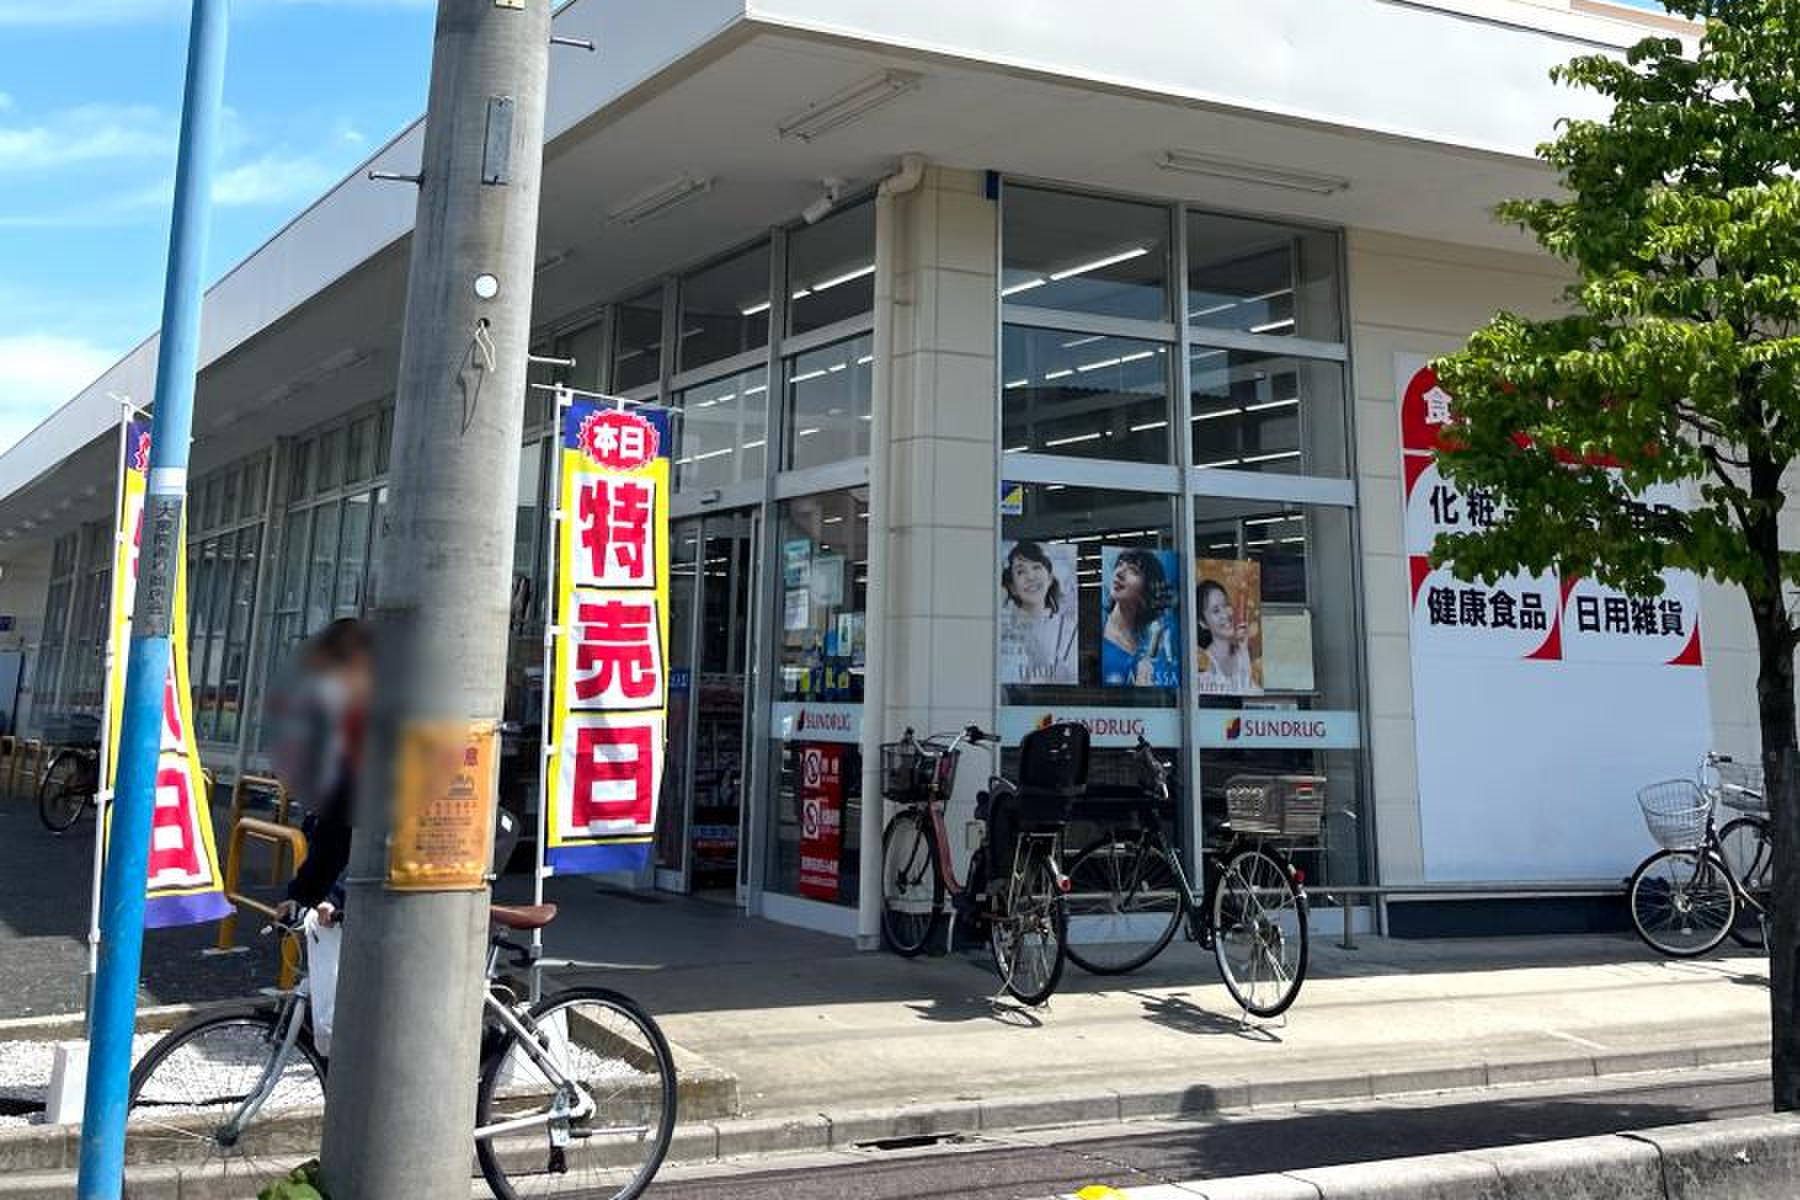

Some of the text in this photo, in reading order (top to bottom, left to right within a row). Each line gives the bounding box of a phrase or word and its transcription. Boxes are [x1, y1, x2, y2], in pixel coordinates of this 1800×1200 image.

[593, 423, 645, 460] 本日
[1427, 586, 1547, 631] 健康食品
[1576, 595, 1685, 637] 日用雑貨
[571, 481, 656, 828] 特売日
[1057, 717, 1146, 737] NDRUG
[1244, 720, 1327, 739] SUNDRUG
